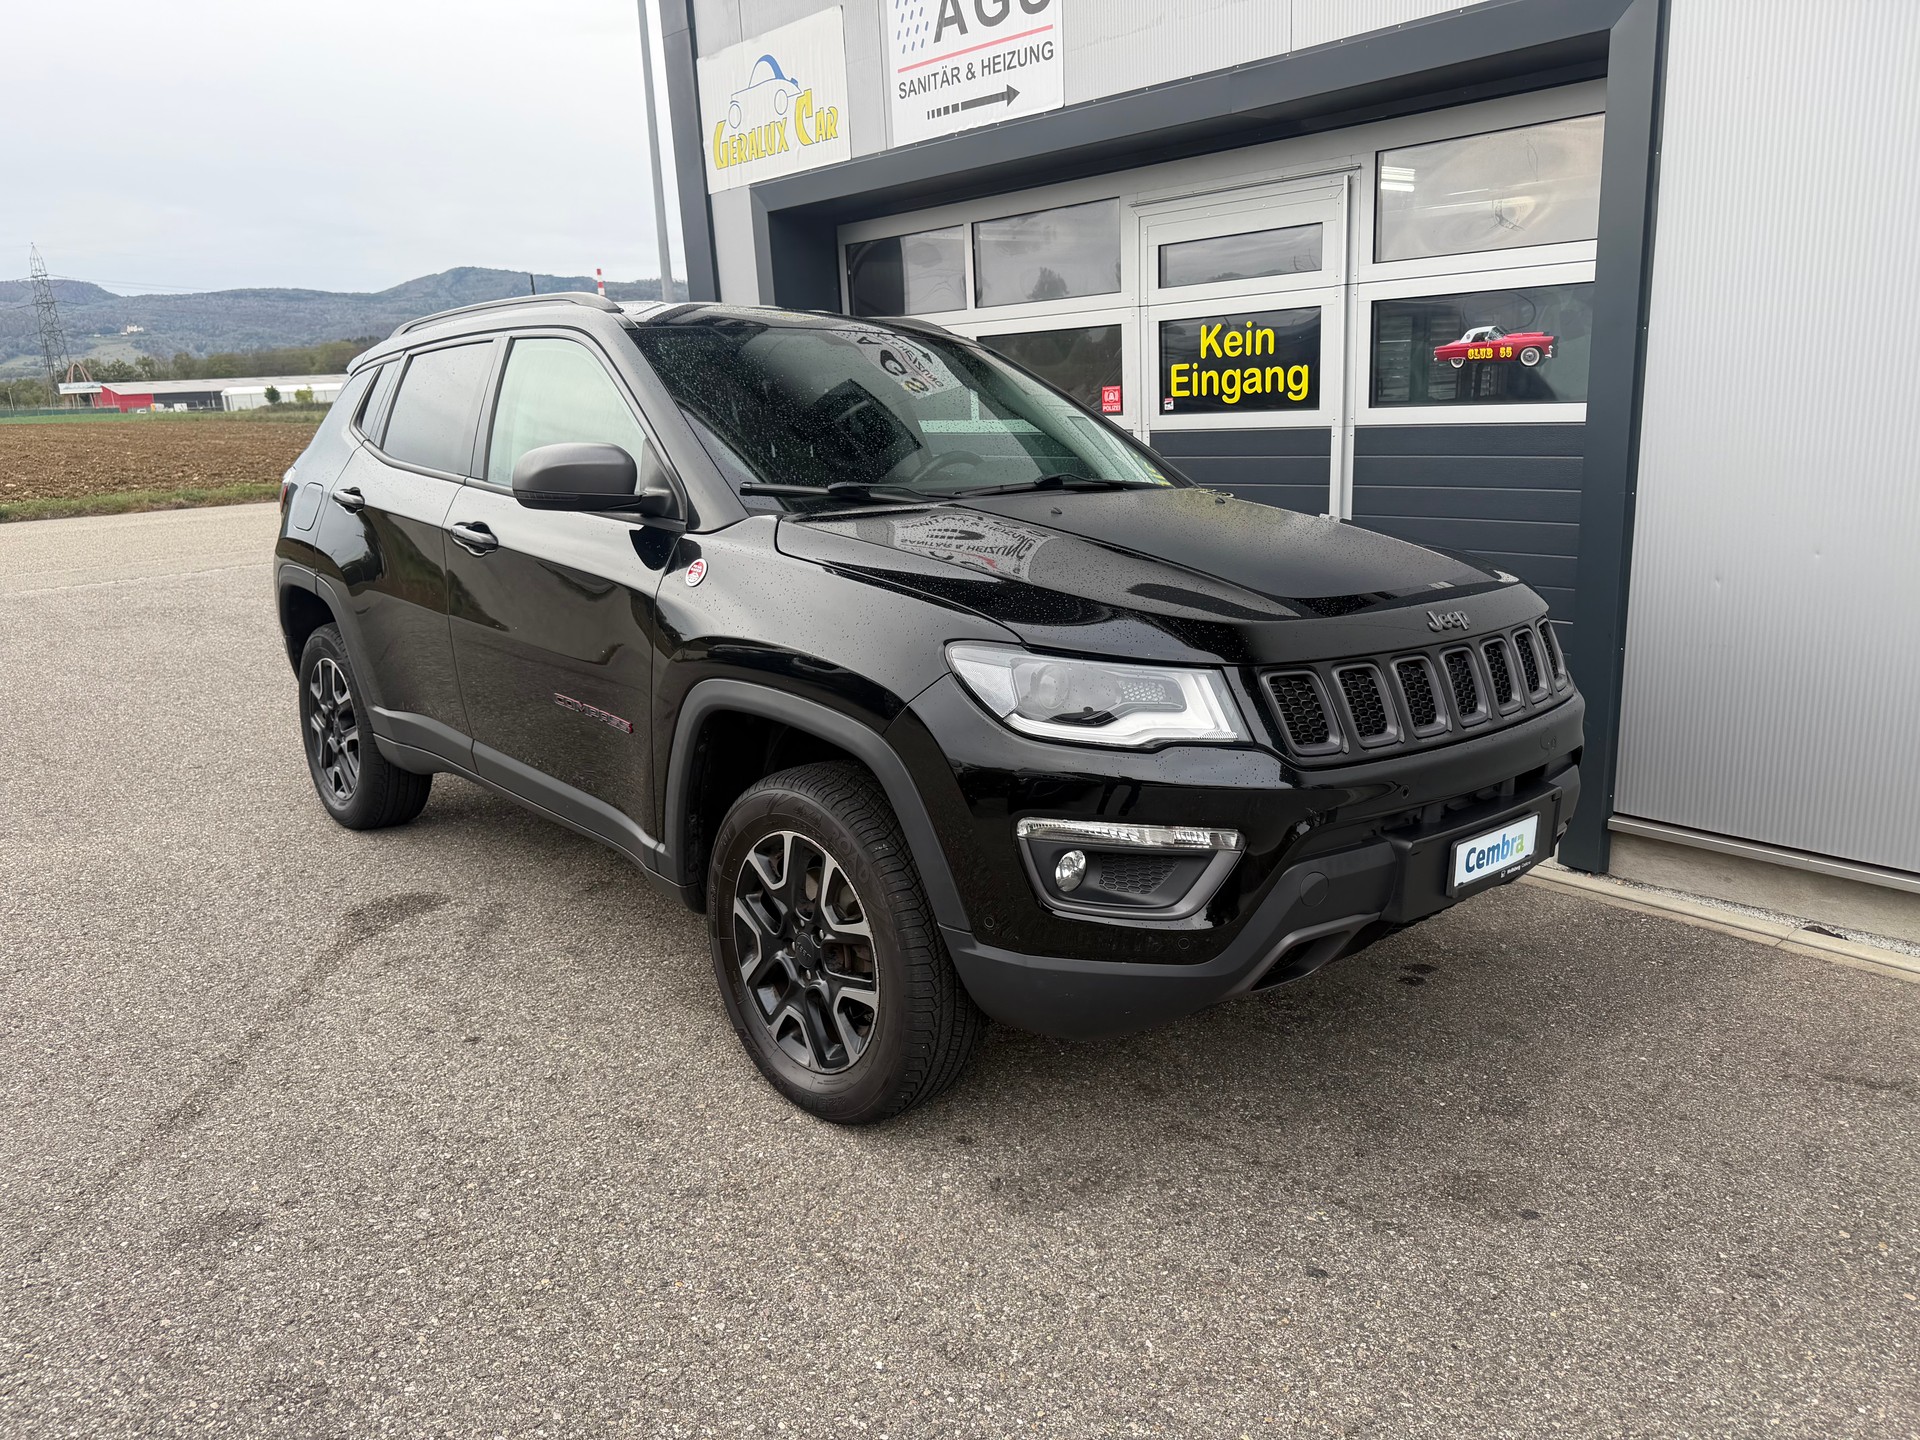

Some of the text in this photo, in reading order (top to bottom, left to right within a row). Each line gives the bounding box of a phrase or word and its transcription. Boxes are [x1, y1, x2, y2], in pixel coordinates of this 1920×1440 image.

[933, 0, 1051, 44] AG
[898, 40, 1054, 100] SANITÄR & HEIZUNG
[713, 117, 789, 170] GERALUX
[1200, 321, 1275, 359] Kein
[1467, 347, 1494, 360] CLUB
[1170, 362, 1309, 404] Eingang
[1427, 609, 1471, 632] Jeep
[1464, 831, 1525, 874] Cembra
